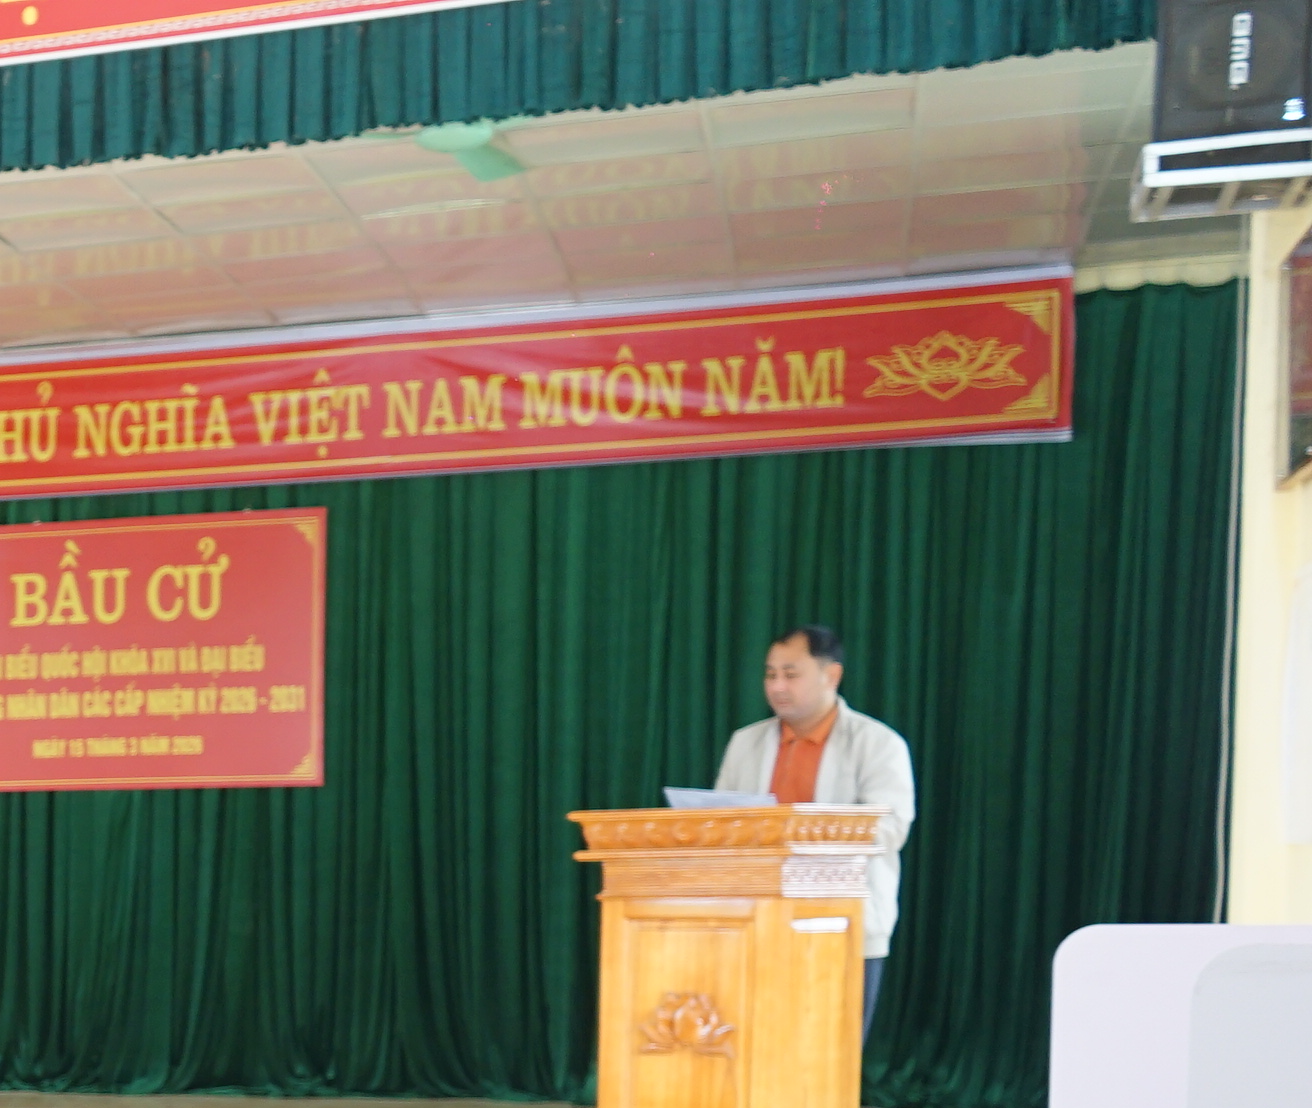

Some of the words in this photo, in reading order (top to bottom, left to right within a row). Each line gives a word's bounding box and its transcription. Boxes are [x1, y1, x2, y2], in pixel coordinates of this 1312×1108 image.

[72, 382, 235, 459] NGHĨA
[249, 369, 370, 458] VIỆT
[381, 375, 506, 438] NAM
[519, 344, 684, 430] MUÔN
[700, 337, 847, 416] NĂM!
[10, 539, 131, 627] BẦU
[146, 536, 230, 622] CỬ
